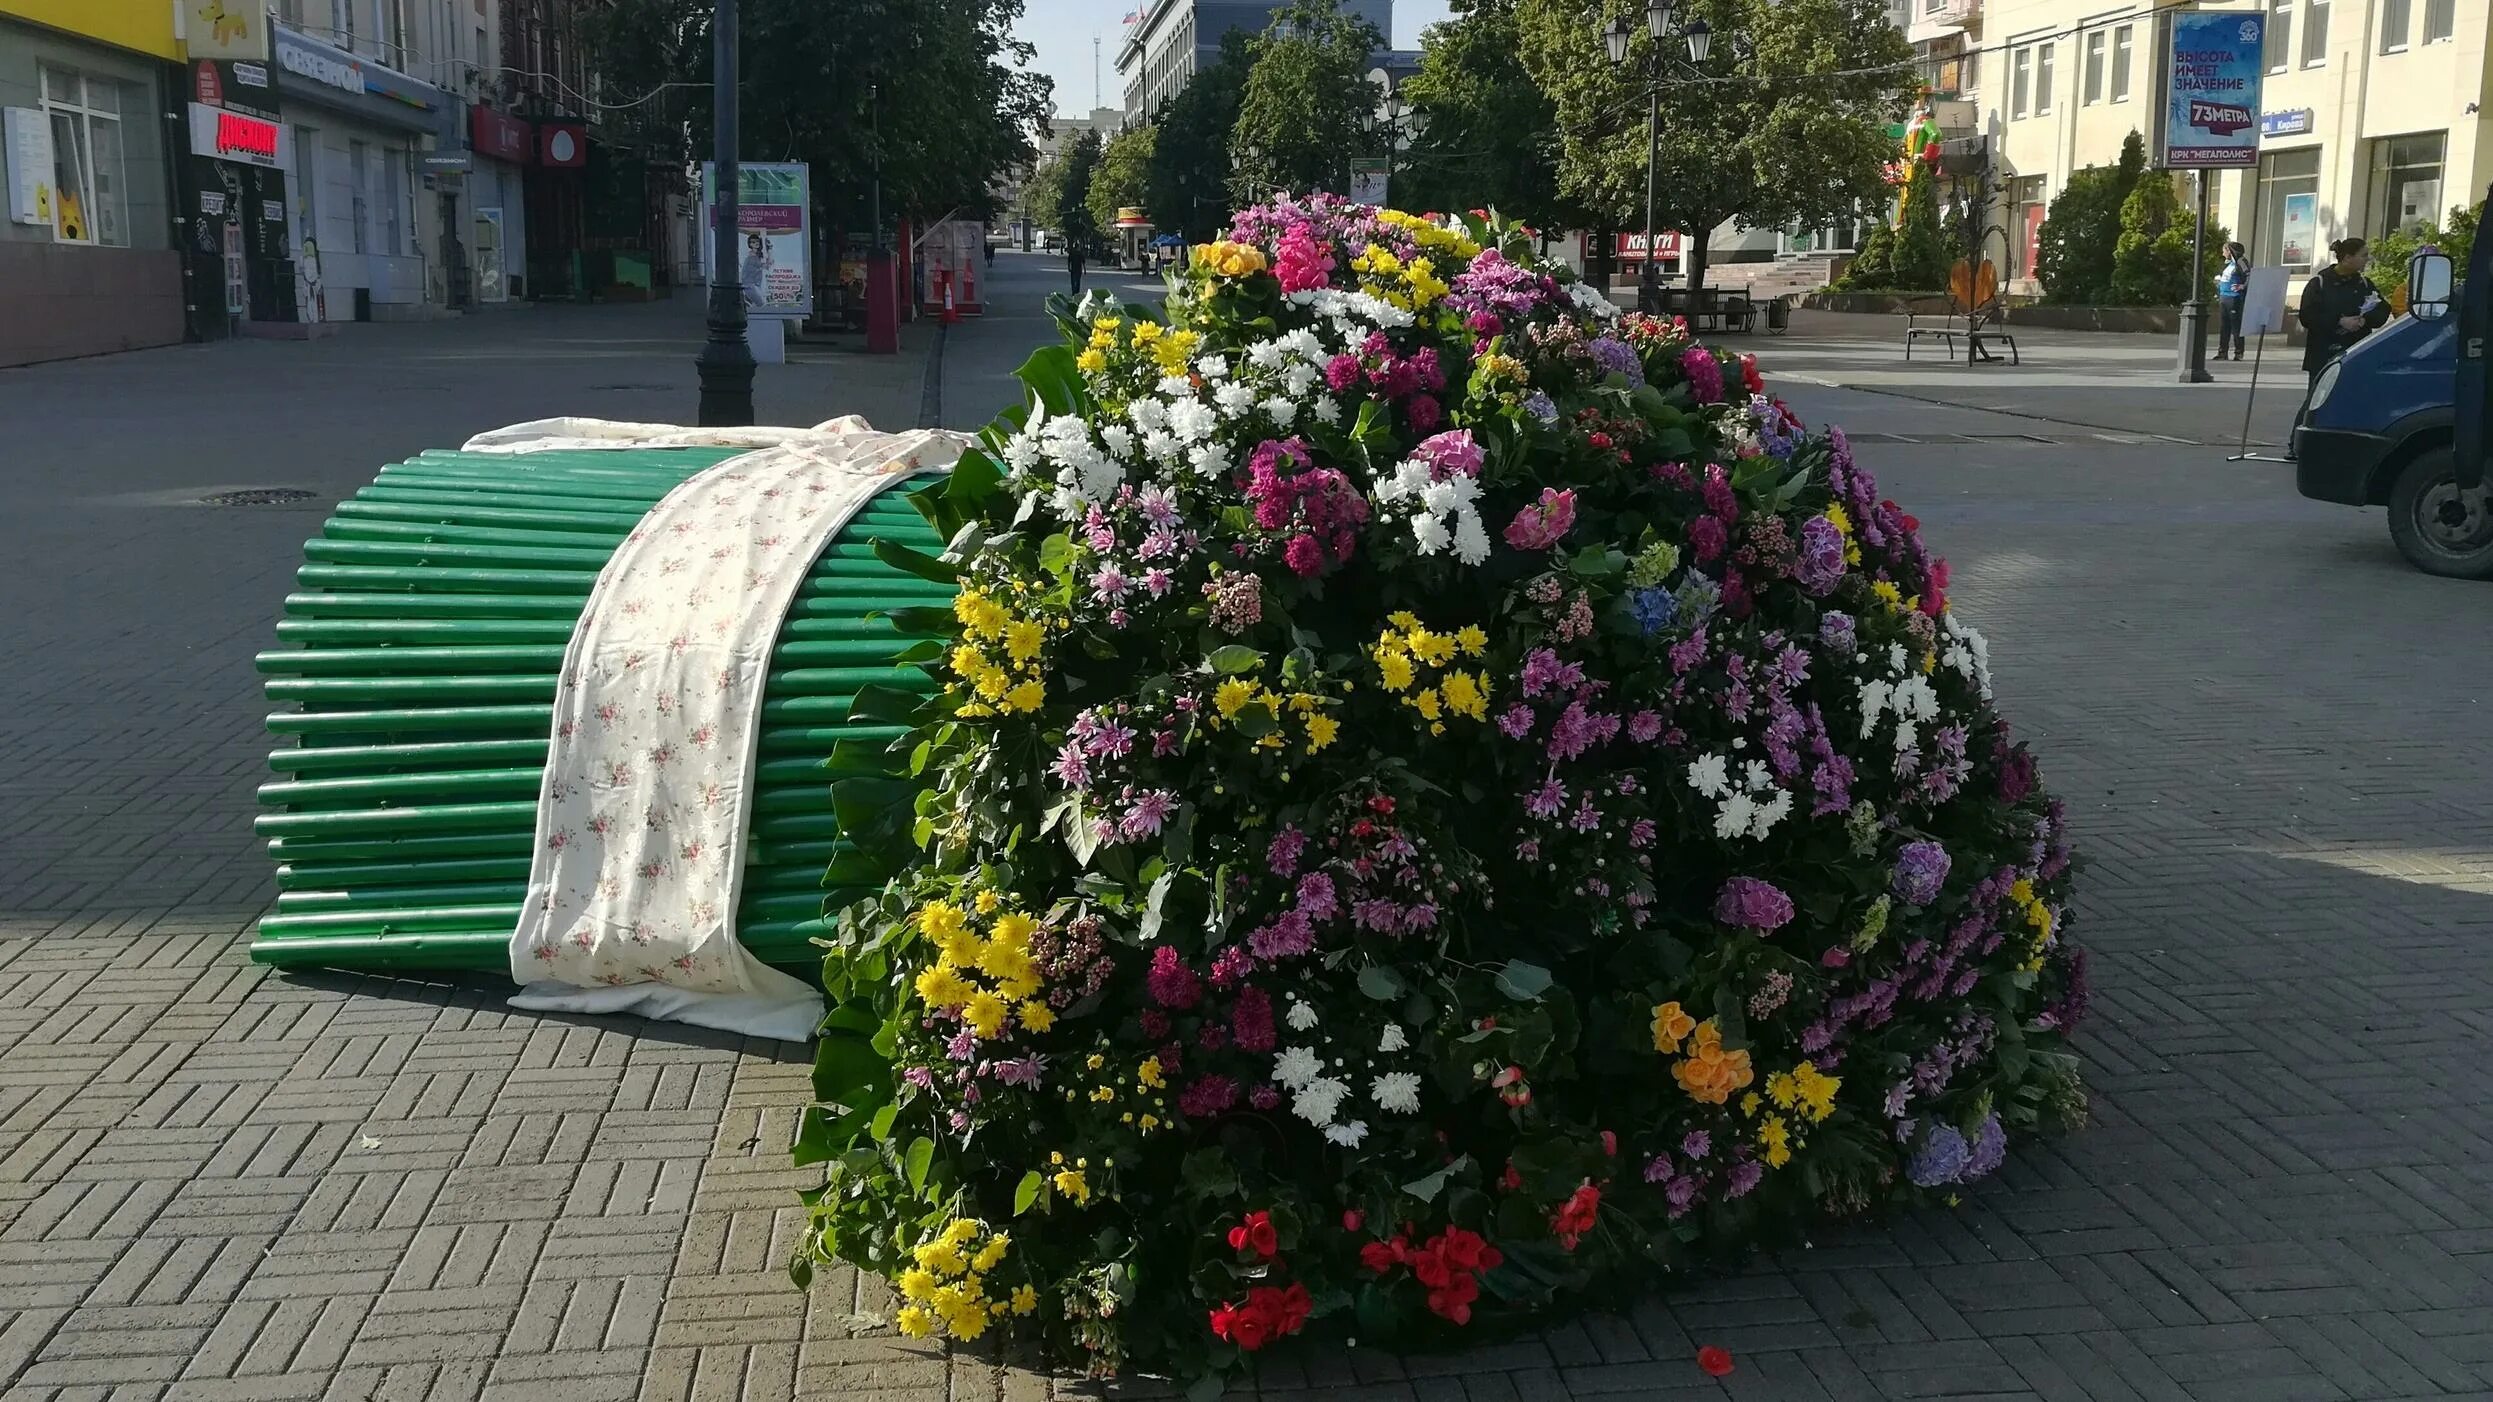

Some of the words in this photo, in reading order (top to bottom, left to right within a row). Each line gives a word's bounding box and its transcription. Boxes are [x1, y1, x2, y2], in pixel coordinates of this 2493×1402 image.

[2175, 50, 2234, 63] ВЫСОТА
[2175, 64, 2218, 77] ИМЕЕТ
[2175, 78, 2244, 90] ЗНАЧЕНИЕ
[2277, 120, 2304, 131] Кирова
[2171, 150, 2189, 159] КРК
[2190, 149, 2252, 159] "МЕГАПОЛИС"
